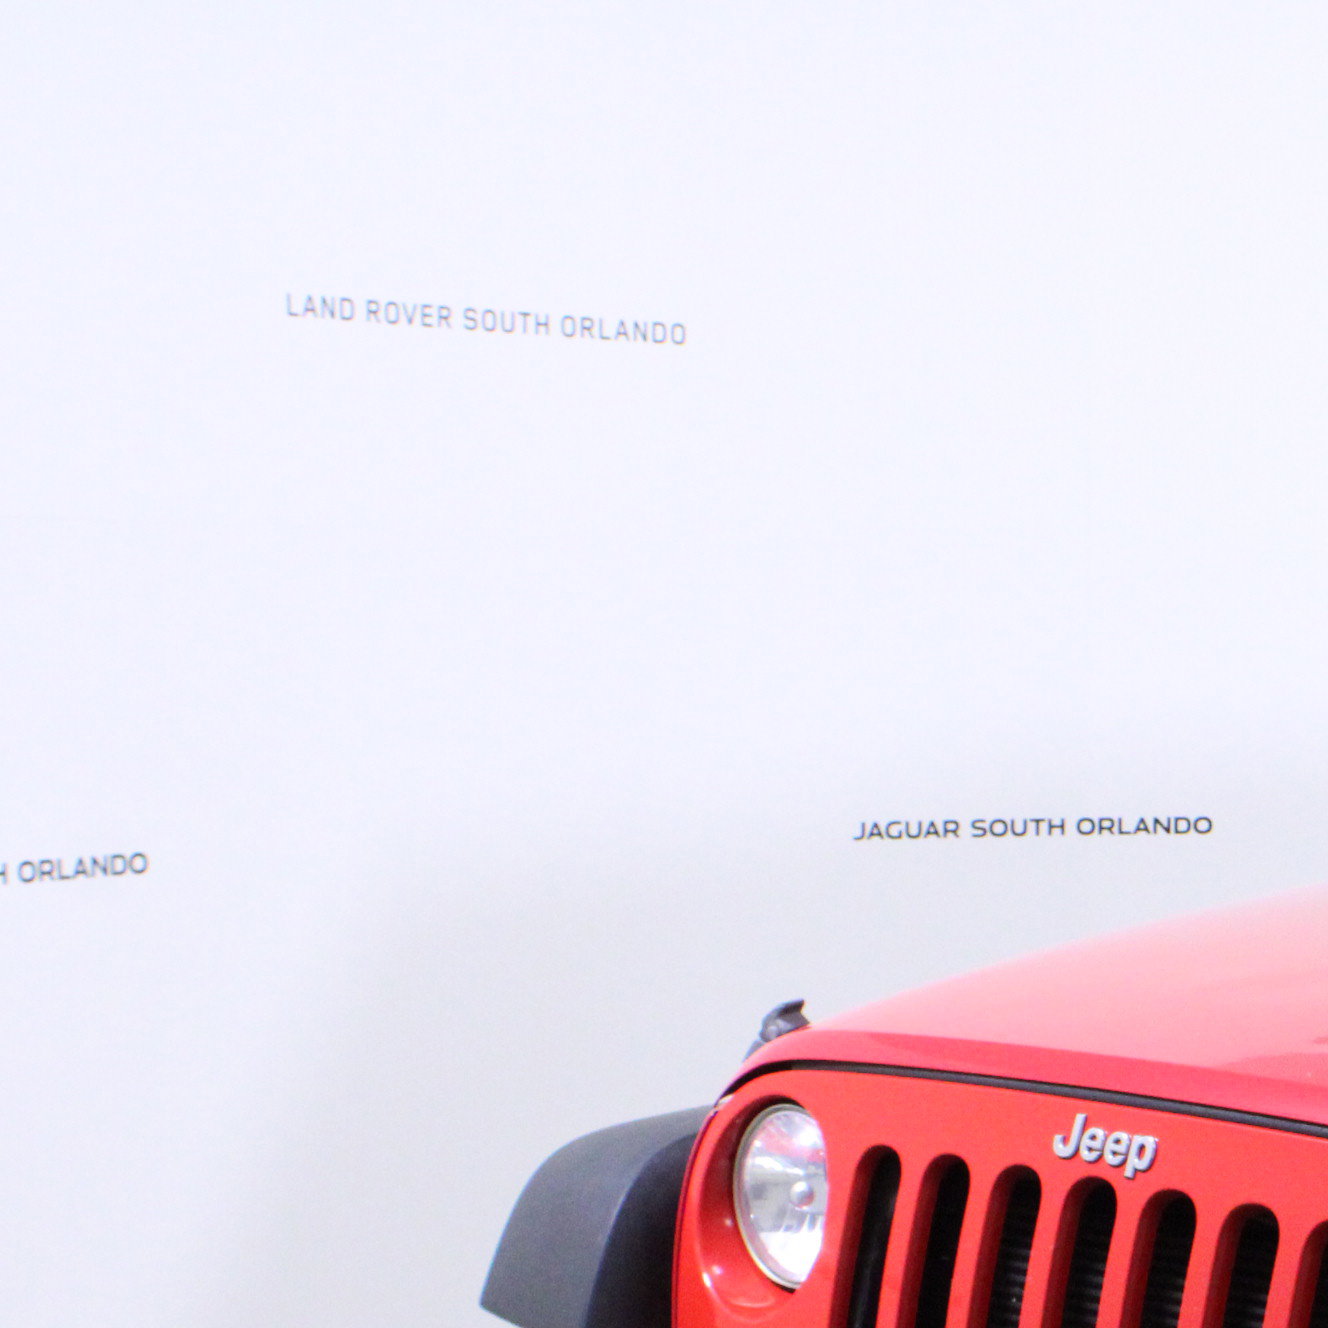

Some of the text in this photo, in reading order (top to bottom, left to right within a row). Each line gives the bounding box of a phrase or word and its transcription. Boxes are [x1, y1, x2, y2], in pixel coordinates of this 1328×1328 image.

[286, 293, 687, 346] LAND ROVER SOUTH ORLANDO
[853, 816, 1214, 841] JAGUAR SOUTH ORLANDO
[17, 852, 149, 884] ORLANDO
[1053, 1113, 1158, 1180] Jeep
